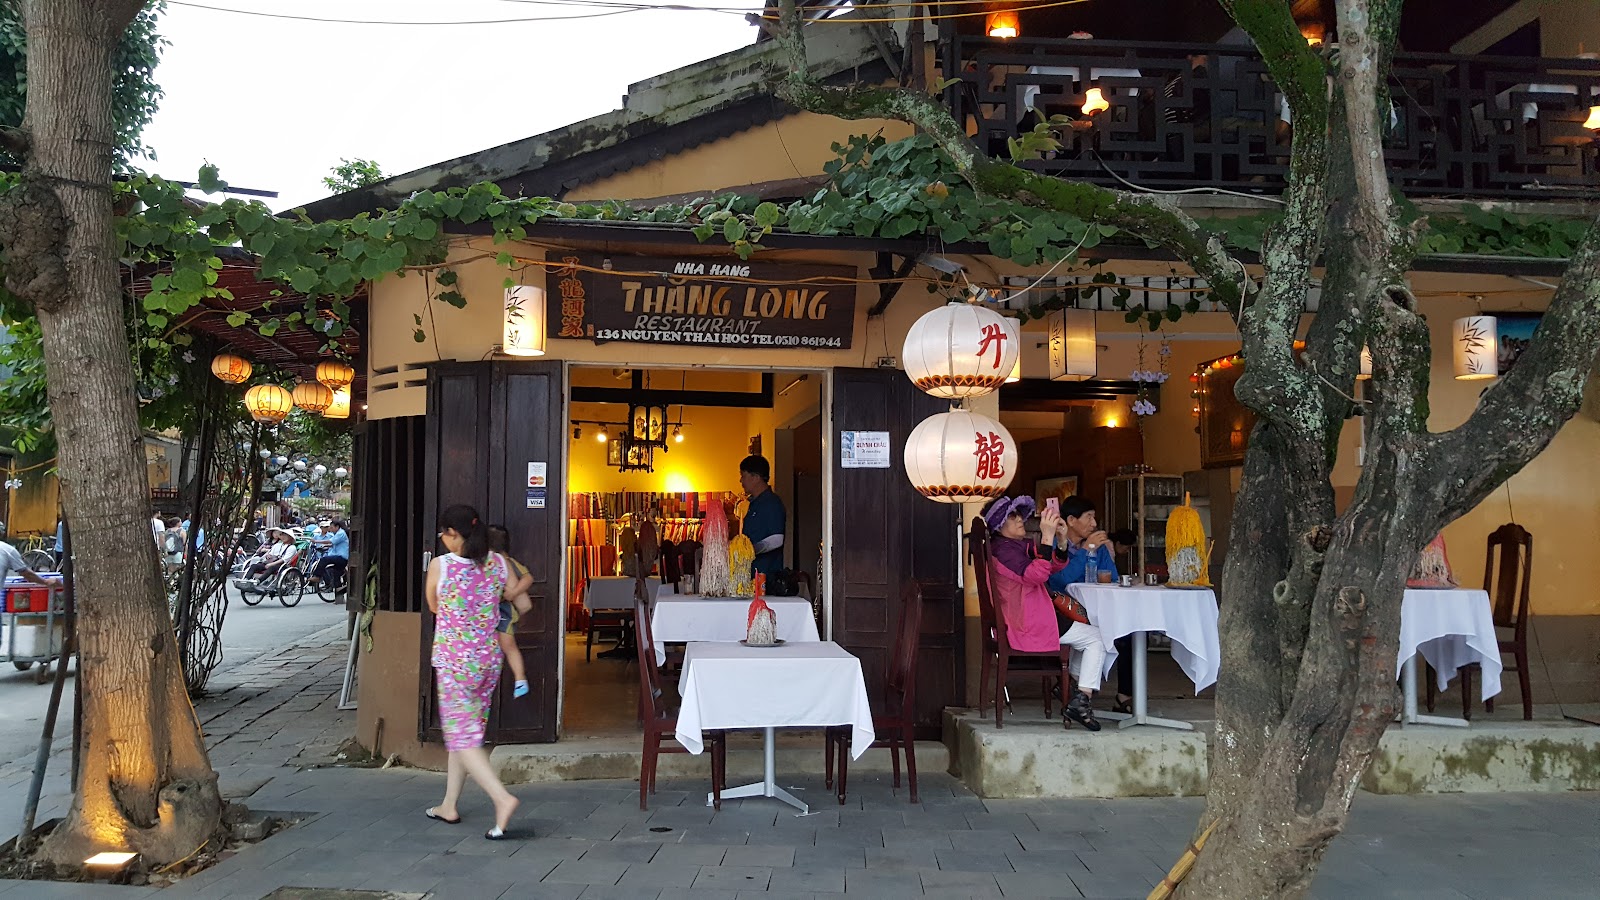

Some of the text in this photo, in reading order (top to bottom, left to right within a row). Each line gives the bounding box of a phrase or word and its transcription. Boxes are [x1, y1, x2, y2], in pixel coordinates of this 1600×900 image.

[673, 262, 750, 277] NHA HANG
[742, 287, 829, 320] LONG
[634, 315, 761, 334] RESTAURANT
[596, 329, 620, 339] 136
[621, 329, 682, 342] NGUYEN
[683, 332, 720, 343] THAI
[721, 333, 750, 344] HOC
[801, 336, 841, 347] 861944
[976, 323, 1007, 370] 升
[973, 431, 1005, 480] 龍
